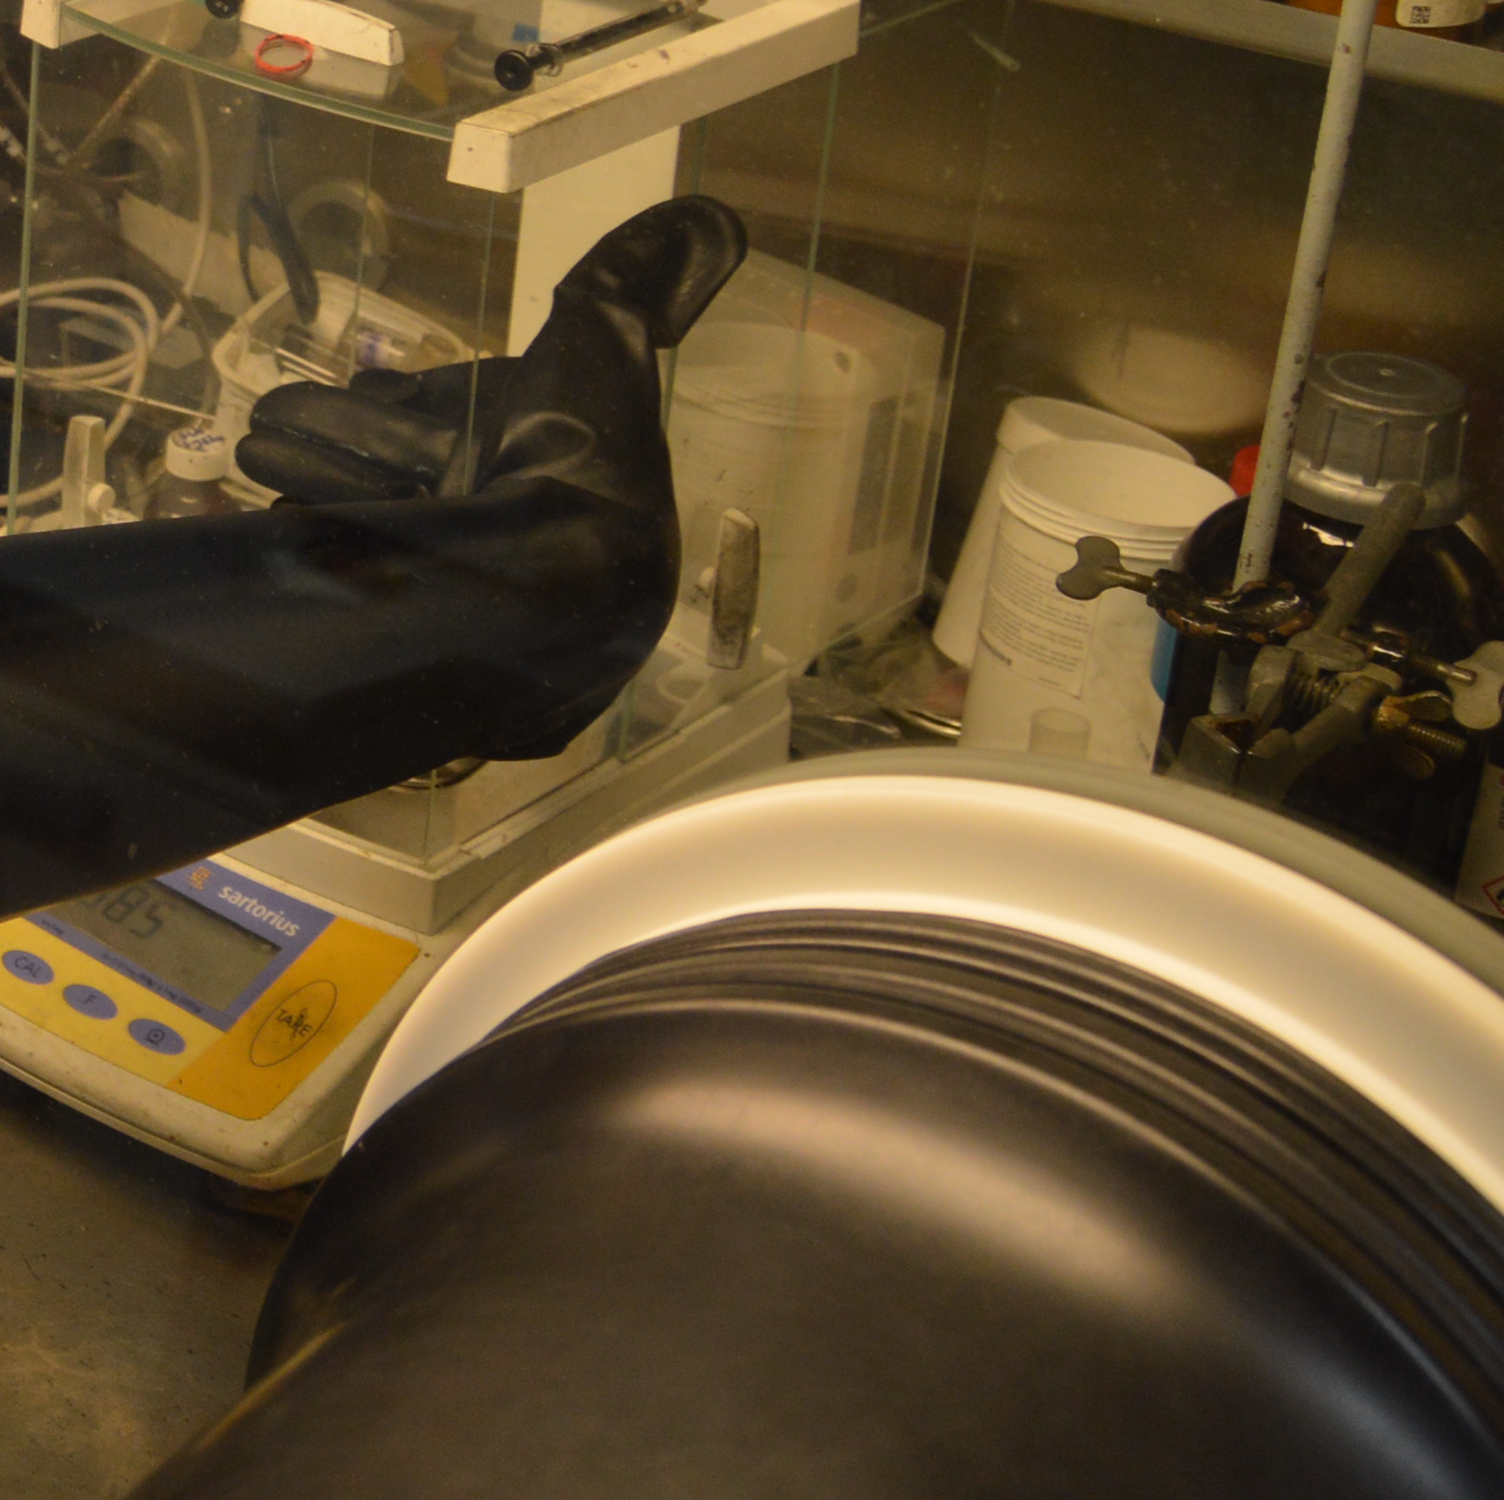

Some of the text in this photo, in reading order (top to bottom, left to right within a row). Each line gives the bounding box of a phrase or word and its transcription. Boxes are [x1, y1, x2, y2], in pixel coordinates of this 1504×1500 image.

[217, 883, 301, 937] sartorius
[13, 956, 42, 978] CAL
[83, 994, 97, 1006] F
[275, 1009, 313, 1038] TARE
